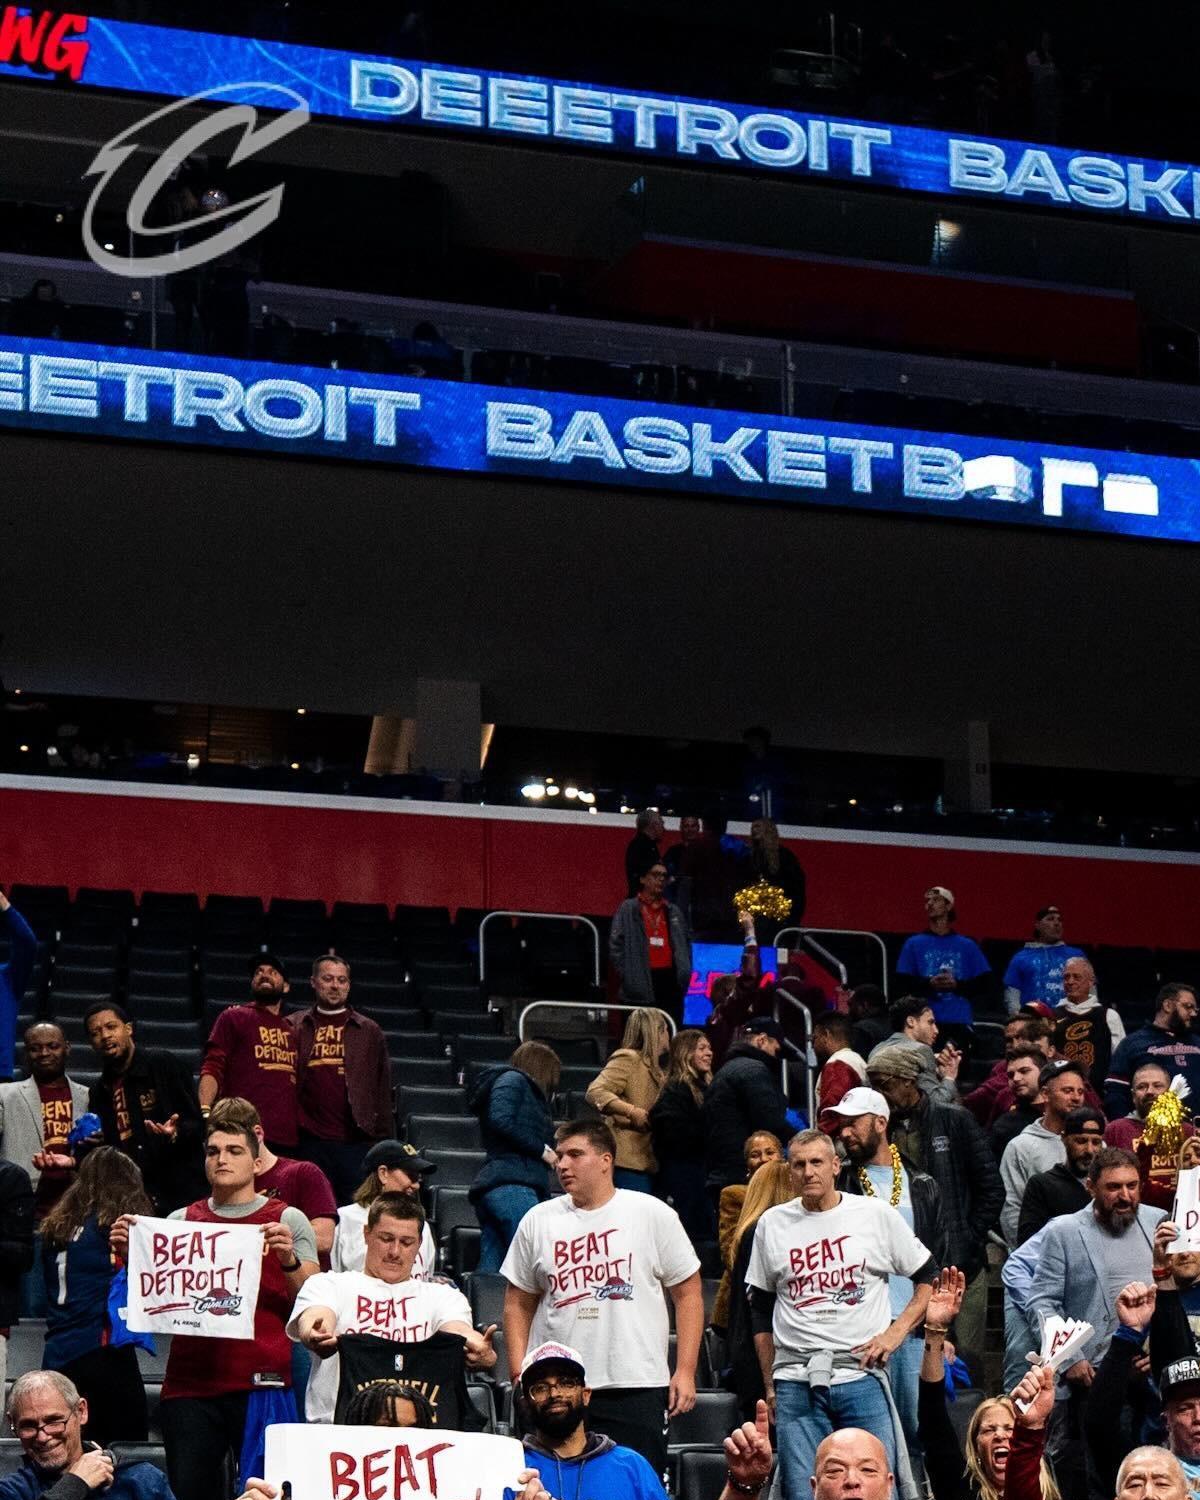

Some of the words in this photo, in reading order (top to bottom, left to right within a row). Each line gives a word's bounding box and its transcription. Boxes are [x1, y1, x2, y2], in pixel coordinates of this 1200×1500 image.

[349, 60, 892, 177] DEEETROIT
[259, 1026, 291, 1048] BEAT
[313, 1025, 344, 1043] EAT
[153, 1231, 231, 1267] BEAT
[554, 1228, 619, 1268] BEAT
[789, 1235, 852, 1275] BEAT
[140, 1259, 243, 1297] DETROIT!
[547, 1252, 633, 1295] DETROIT!
[787, 1257, 866, 1301] DETROIT!
[356, 1294, 417, 1328] BEAT
